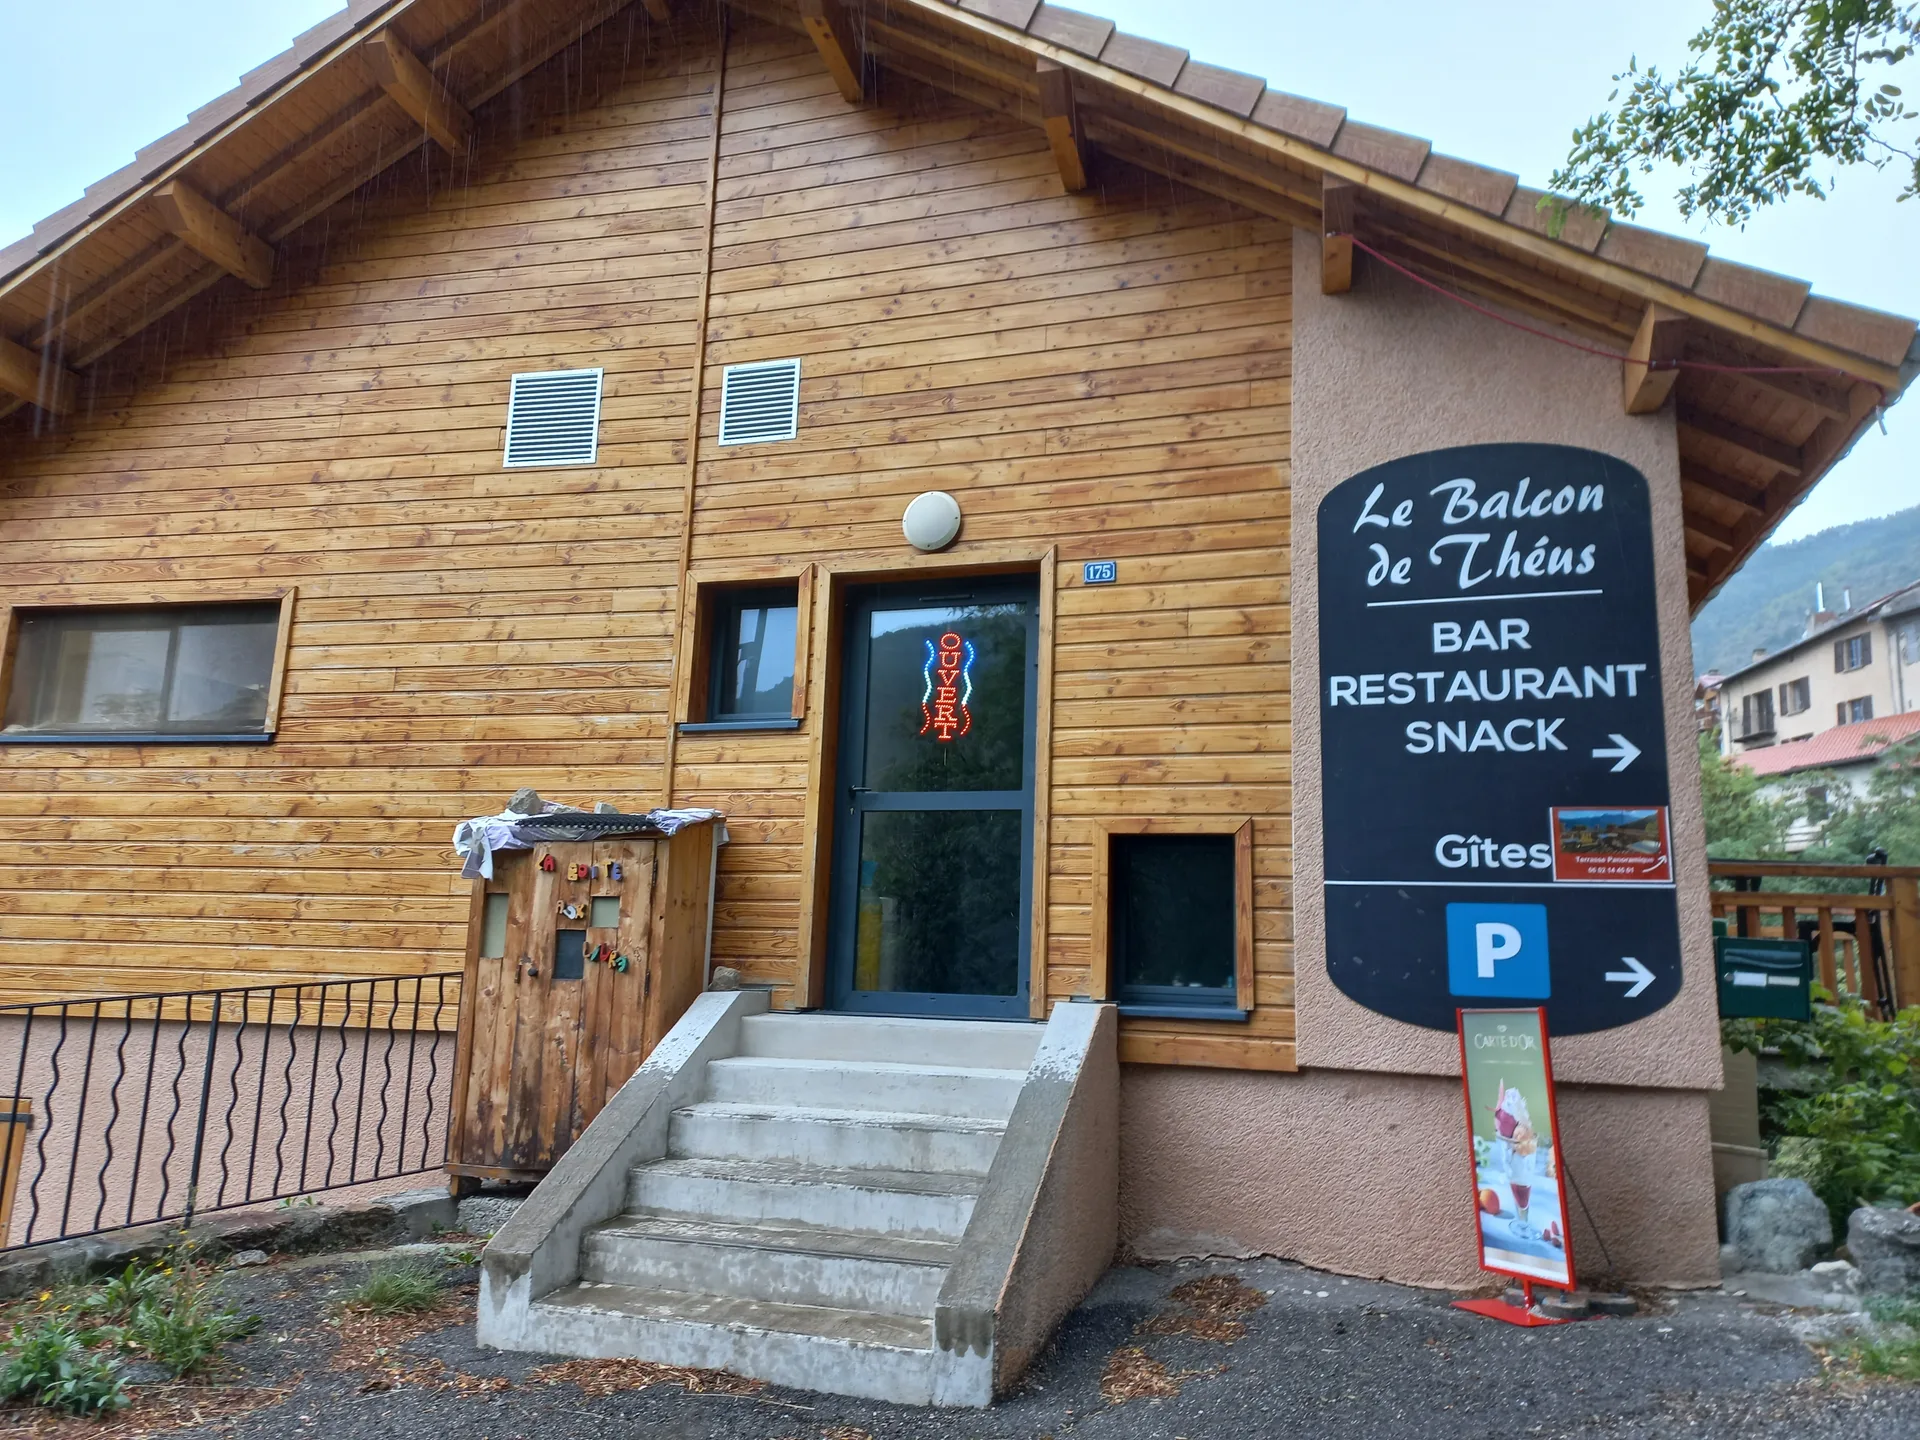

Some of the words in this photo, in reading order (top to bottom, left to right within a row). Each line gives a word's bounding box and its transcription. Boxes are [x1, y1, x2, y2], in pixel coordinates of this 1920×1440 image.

[1353, 482, 1413, 533] Le
[1430, 477, 1605, 525] Balcon
[1088, 565, 1111, 580] 175
[1366, 543, 1412, 587] de
[1430, 530, 1596, 590] Théus
[1433, 618, 1532, 653] BAR
[934, 632, 962, 739] OUVERT
[1330, 663, 1647, 707] RESTAURANT
[1405, 718, 1568, 754] SNACK
[1435, 834, 1551, 869] Gîtes
[1475, 922, 1522, 978] P
[1474, 1033, 1507, 1049] CARTE
